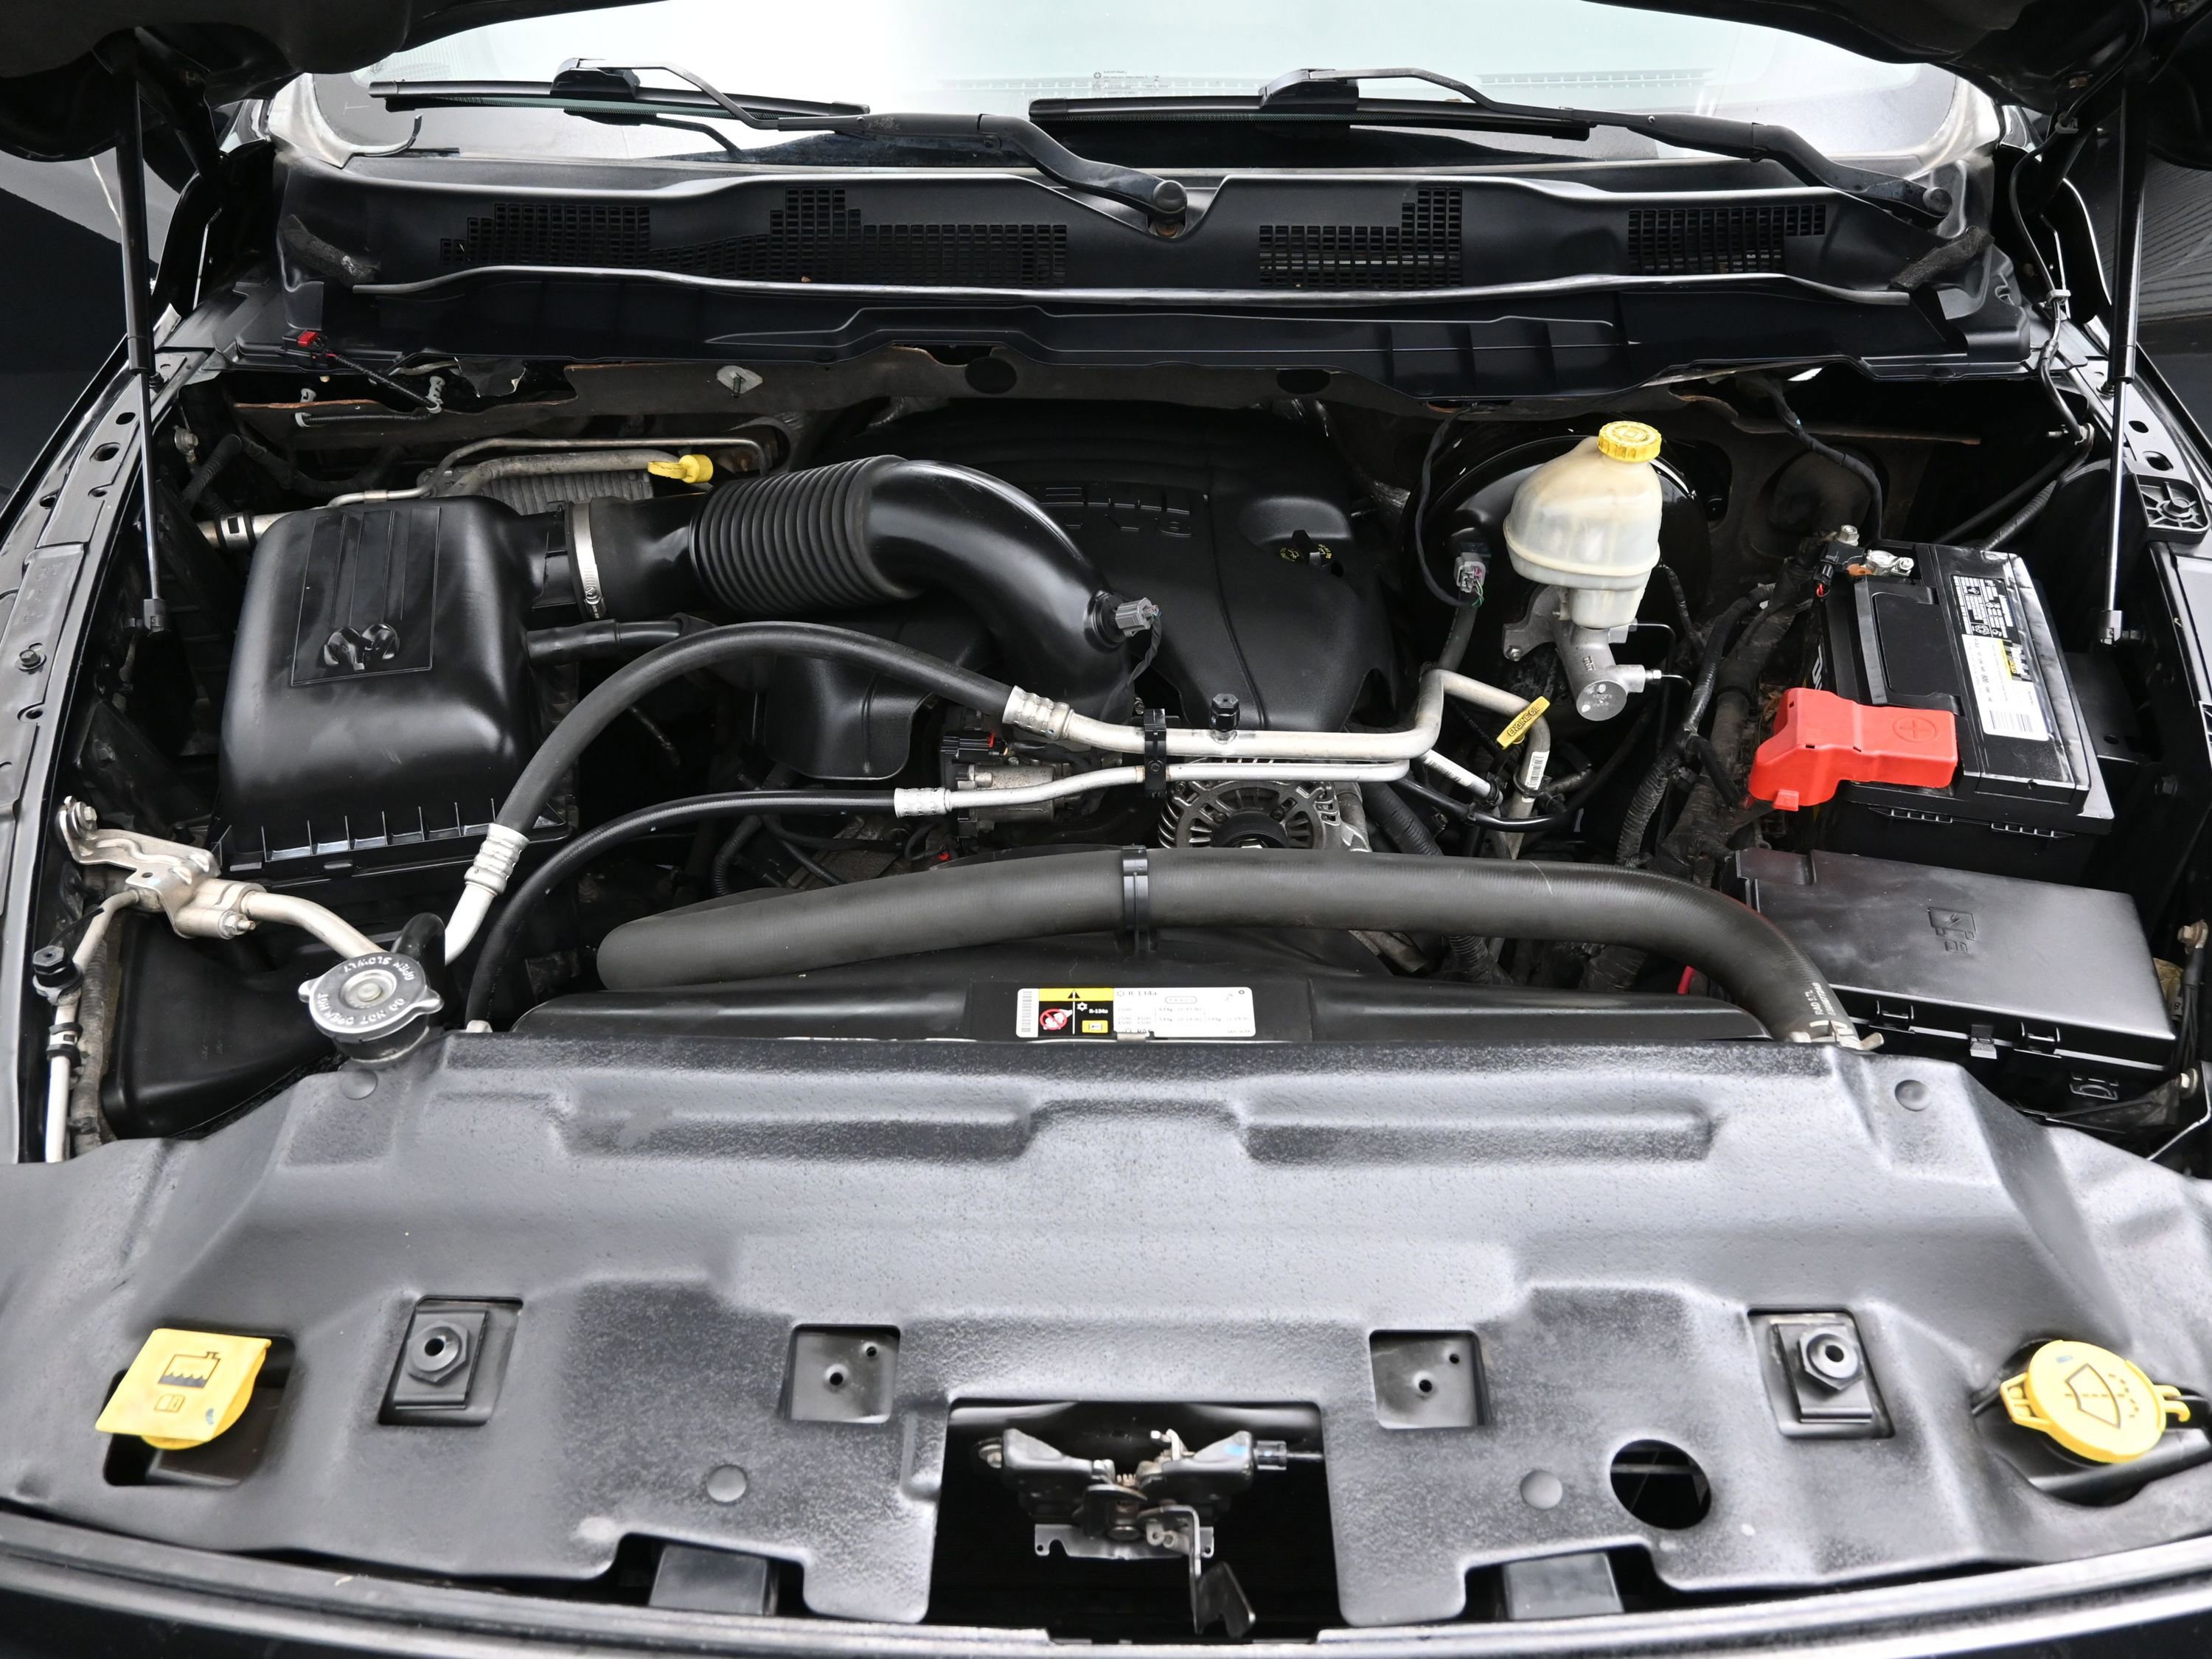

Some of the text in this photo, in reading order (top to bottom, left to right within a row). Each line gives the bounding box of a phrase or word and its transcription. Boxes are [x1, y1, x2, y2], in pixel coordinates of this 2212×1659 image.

[1507, 714, 1531, 736] ENGINE
[1528, 706, 1542, 717] OIL
[344, 956, 415, 981] OPEN SLOWLY
[317, 992, 406, 1026] DO NOT OPEN HOT
